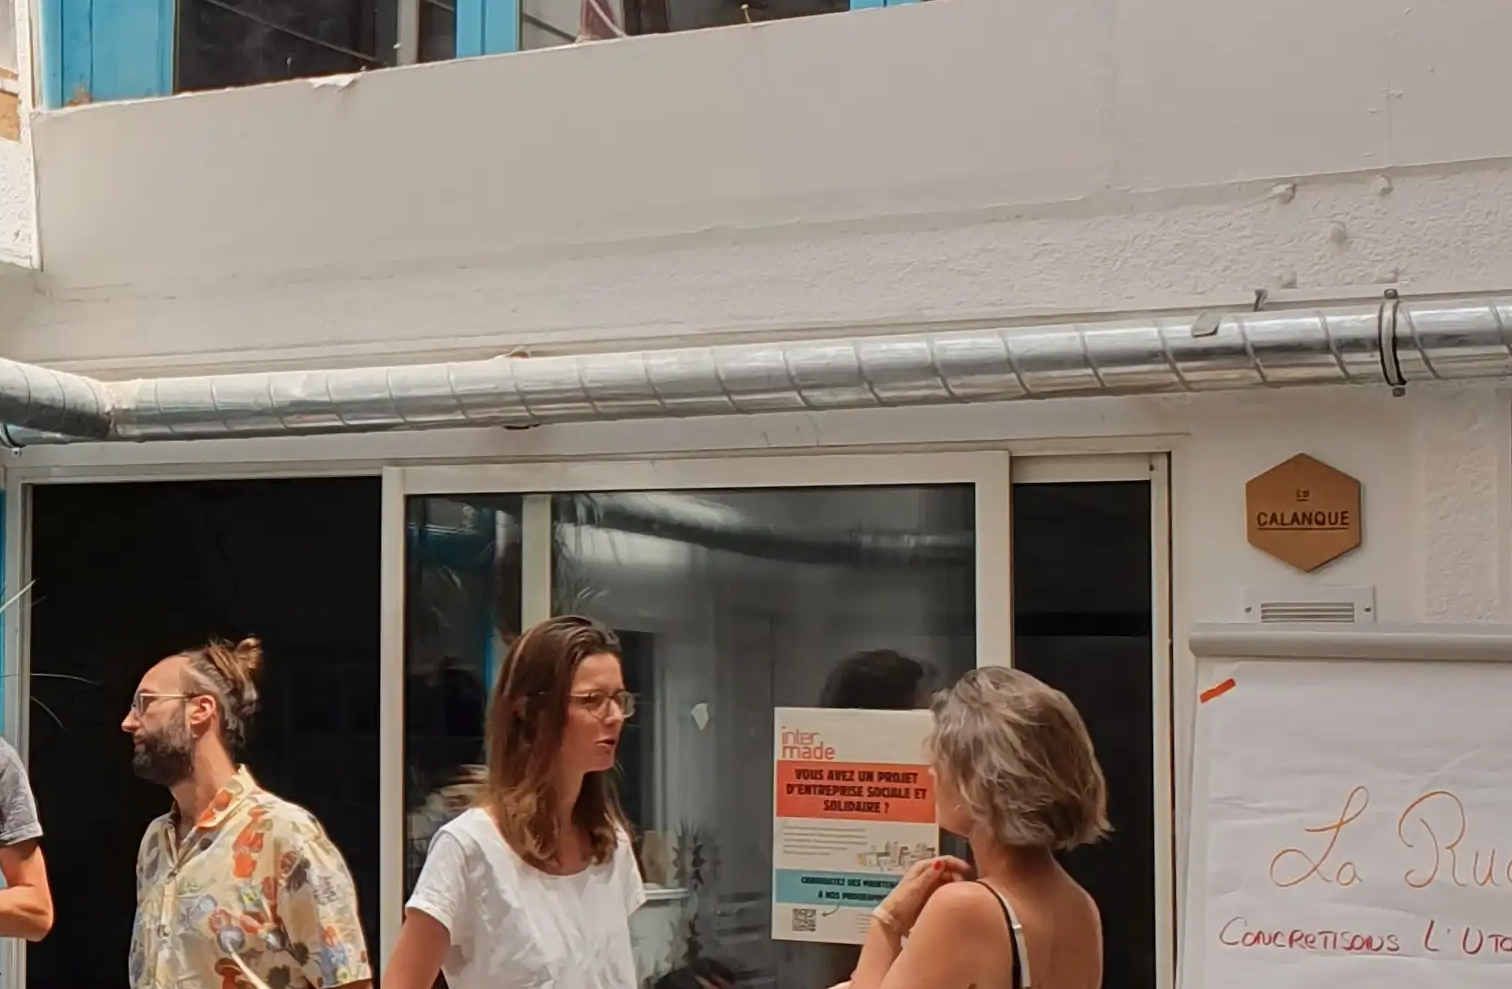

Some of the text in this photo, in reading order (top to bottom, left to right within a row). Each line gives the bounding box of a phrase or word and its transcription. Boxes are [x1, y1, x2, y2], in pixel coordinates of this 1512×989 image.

[1257, 511, 1350, 527] CALANQUE
[782, 726, 819, 745] inter
[782, 741, 835, 760] made
[794, 769, 918, 784] VOUS AVEZ UN PROJET
[786, 783, 927, 799] D'ENTREPRISE SOCIALE ET
[823, 800, 881, 813] SOLIDAIRE
[1269, 785, 1370, 888] La
